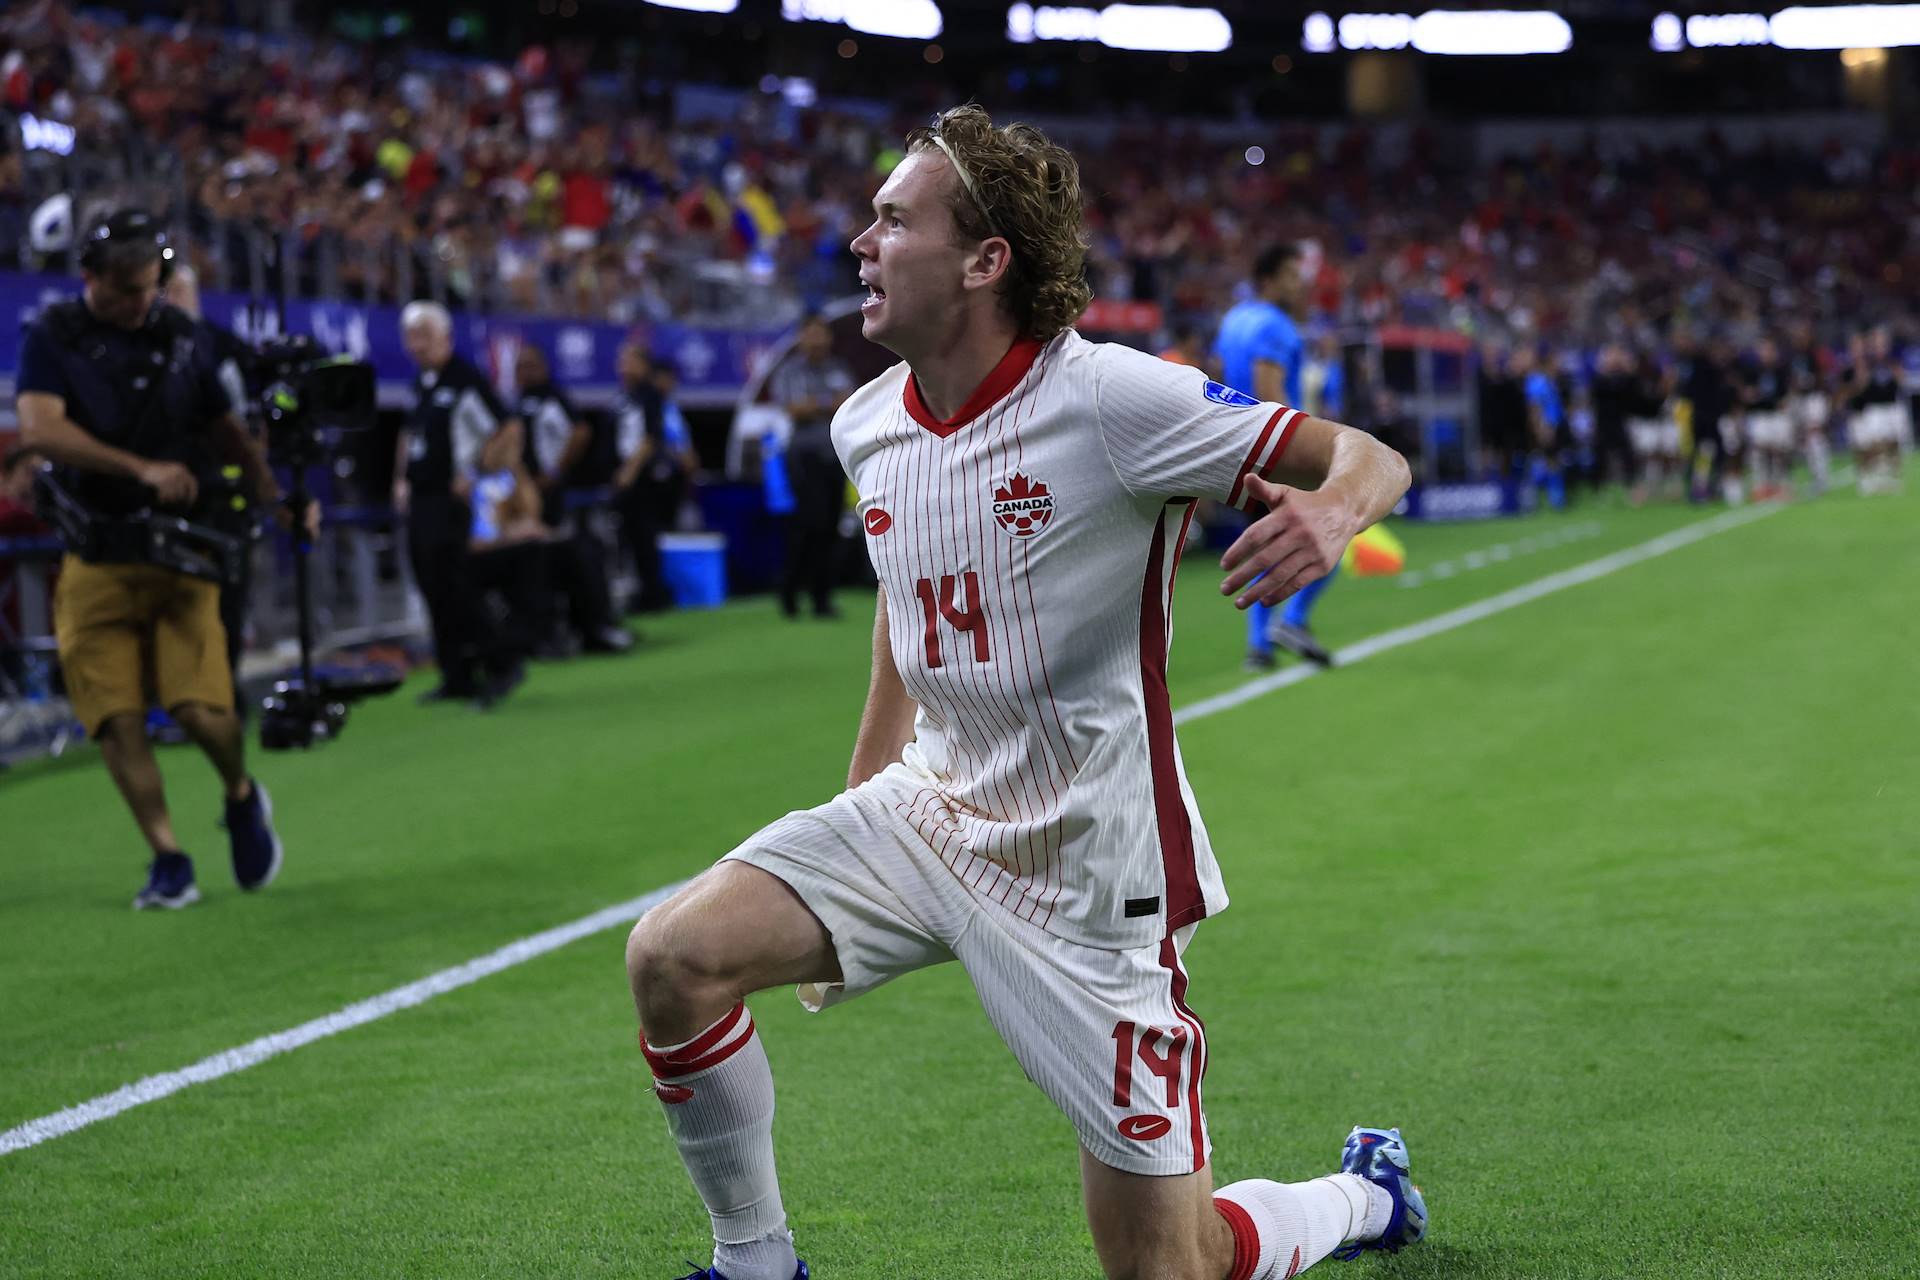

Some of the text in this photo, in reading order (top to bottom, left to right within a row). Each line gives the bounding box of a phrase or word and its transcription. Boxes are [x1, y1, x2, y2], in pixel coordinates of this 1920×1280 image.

[993, 498, 1053, 514] CANADA
[917, 572, 990, 668] 14
[1111, 1021, 1187, 1107] 14
